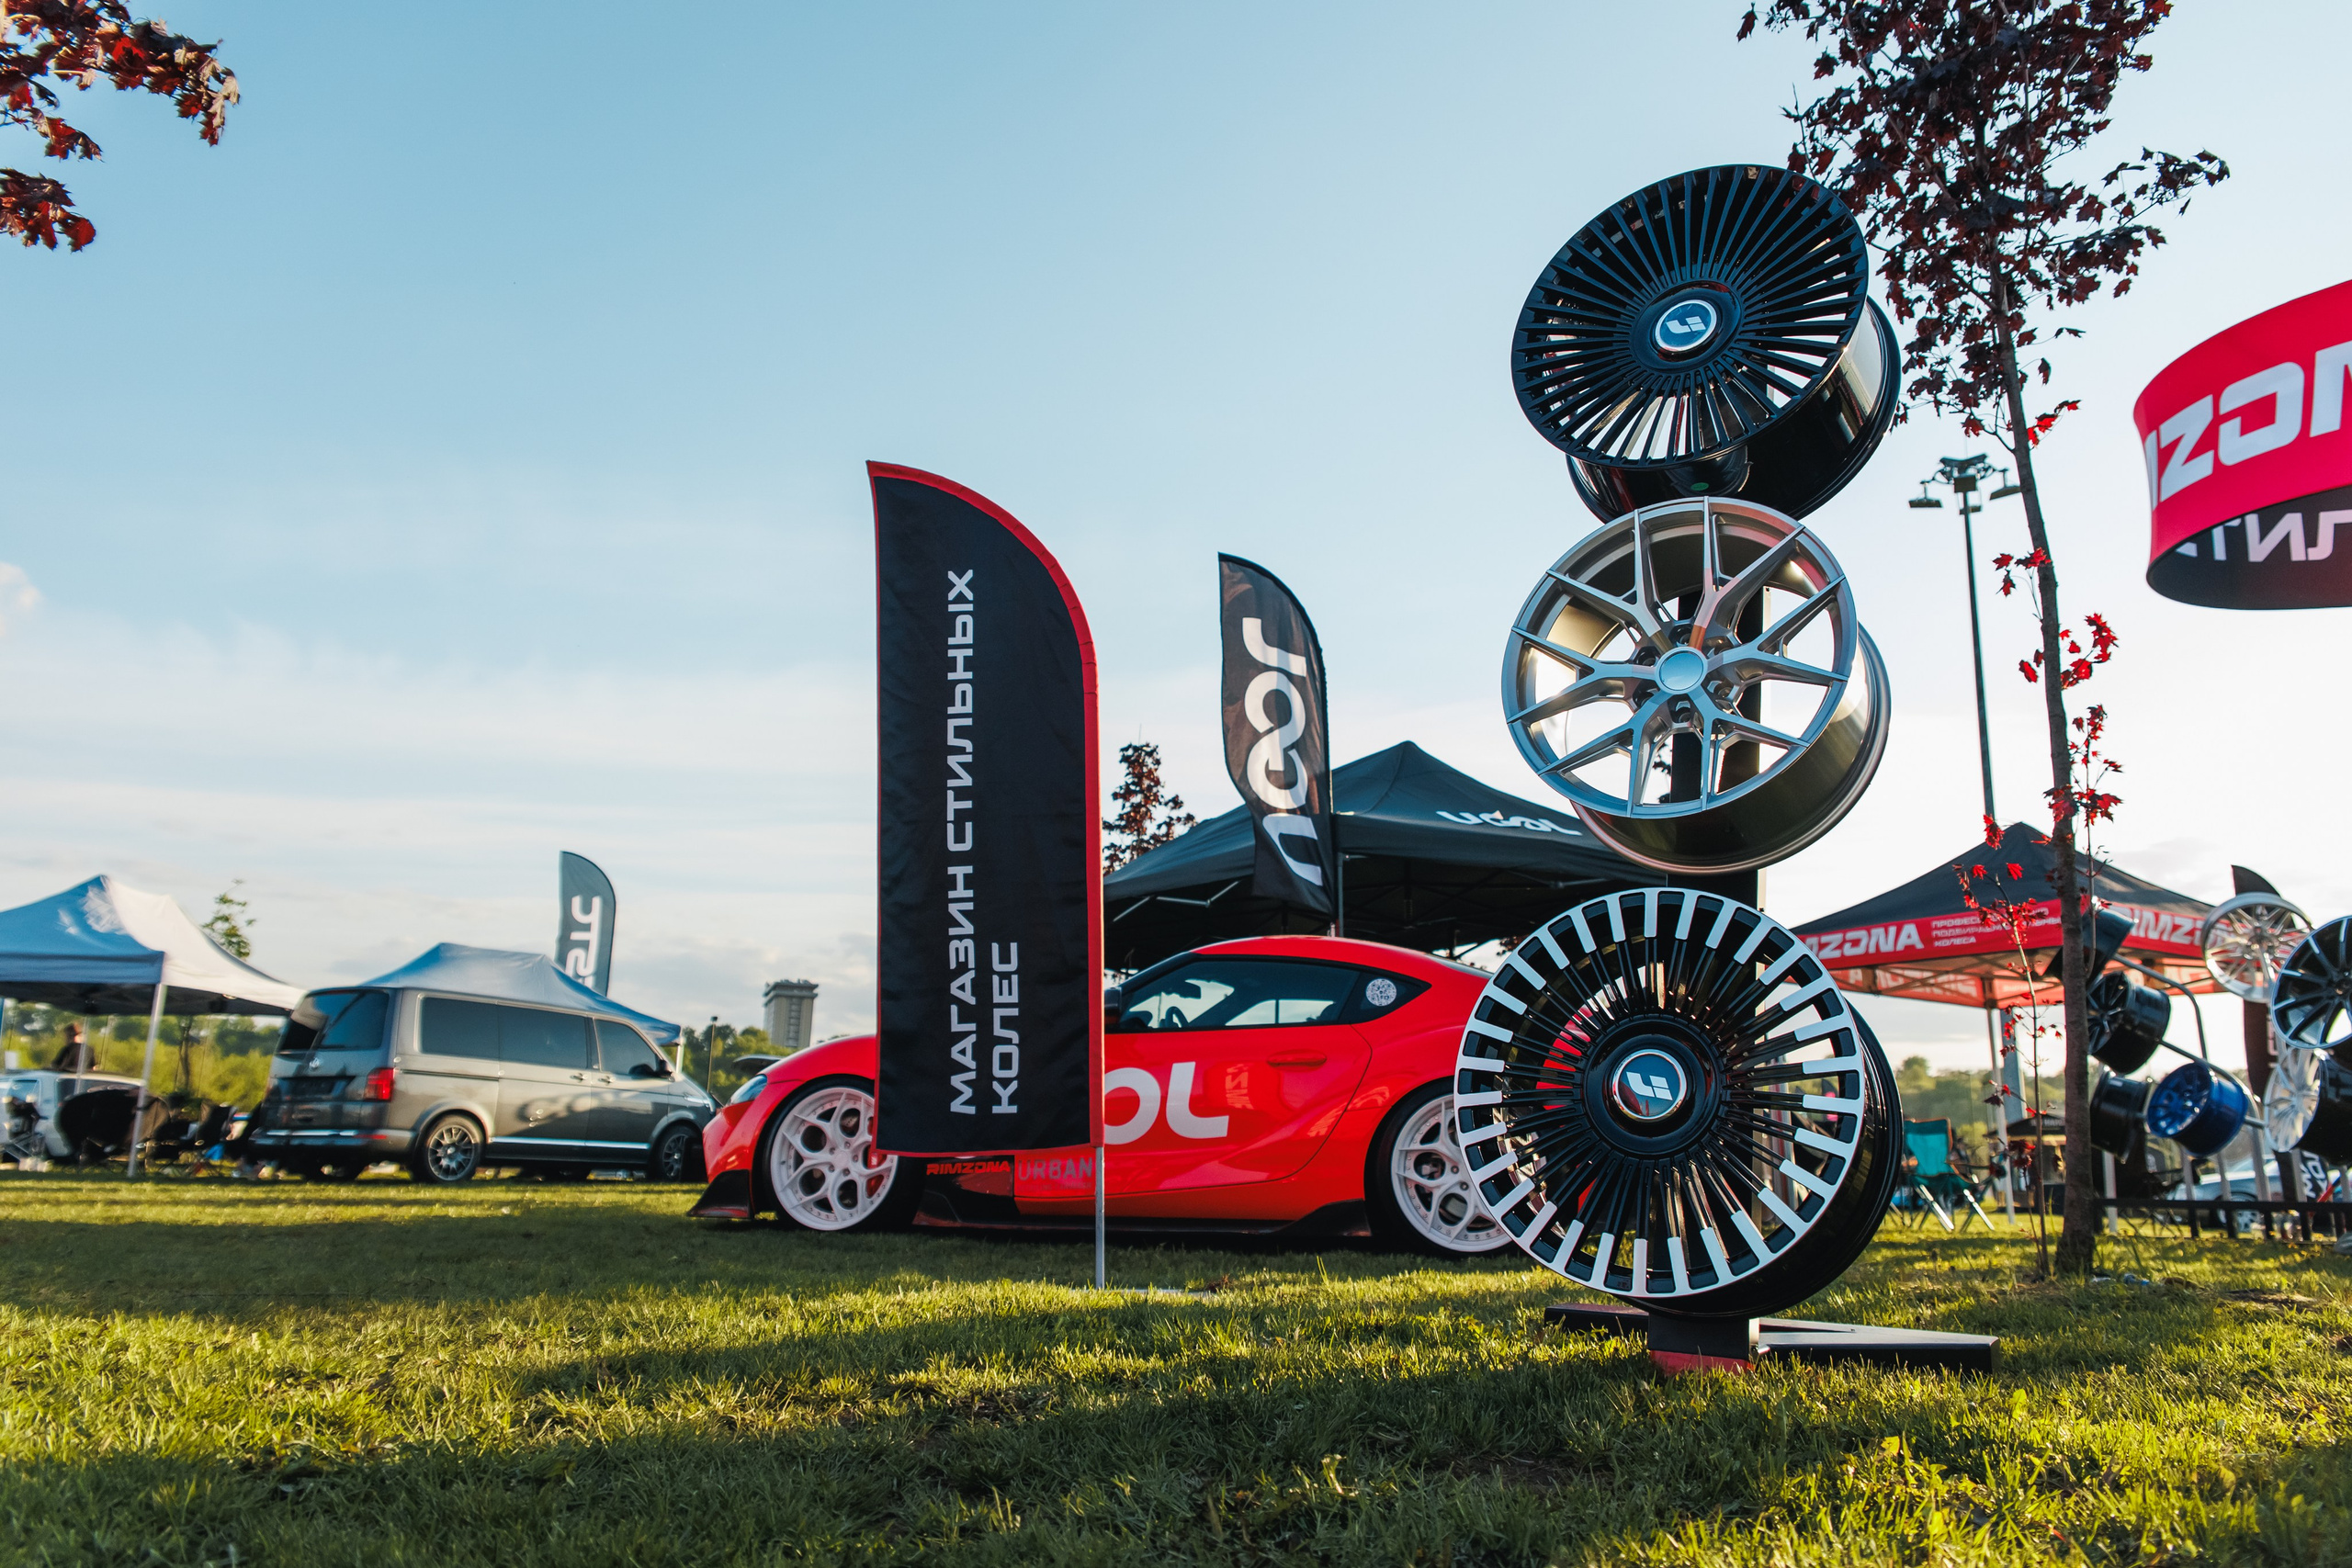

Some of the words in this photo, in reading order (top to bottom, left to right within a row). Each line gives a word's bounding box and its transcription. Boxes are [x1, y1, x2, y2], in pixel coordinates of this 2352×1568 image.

[946, 570, 974, 852] СТИЛЬНЫХ
[946, 865, 977, 1114] МАГАЗИН
[991, 942, 1019, 1113] КОЛЕС
[926, 1160, 1011, 1175] RIMZONA
[1018, 1156, 1093, 1180] URBAN
